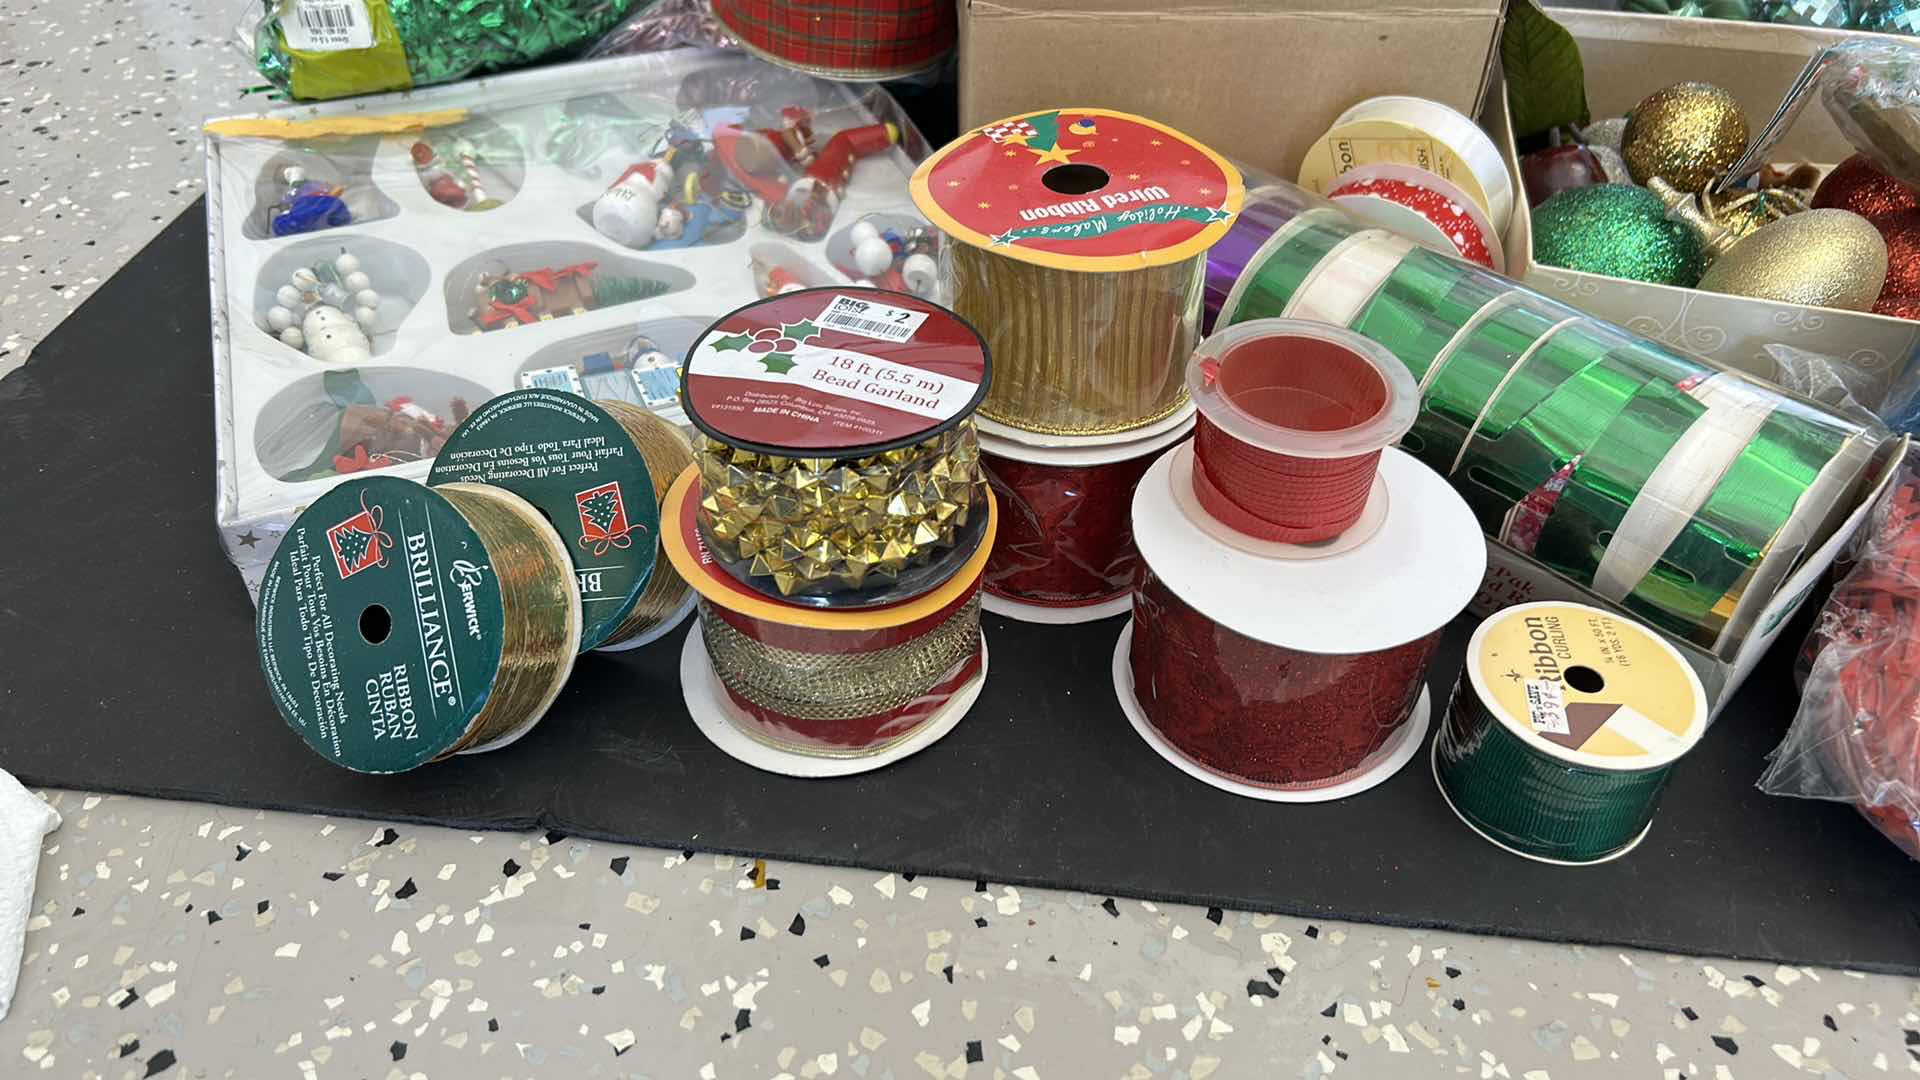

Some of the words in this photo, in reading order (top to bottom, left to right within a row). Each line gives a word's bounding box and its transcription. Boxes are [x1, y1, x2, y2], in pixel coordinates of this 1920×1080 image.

[1100, 186, 1170, 209] Wired
[1019, 198, 1101, 222] Ribbon
[828, 356, 854, 370] 18
[857, 362, 873, 376] ft
[874, 367, 914, 385] (5.5
[916, 379, 944, 395] m)
[812, 368, 861, 390] Bead
[863, 382, 940, 409] Garland
[753, 406, 779, 414] MADE
[779, 408, 791, 416] IN
[791, 410, 820, 423] CHINA
[500, 446, 512, 457] De
[514, 442, 536, 454] Tipo
[537, 442, 561, 453] Todo
[562, 439, 582, 449] Para
[584, 436, 605, 448] Ideal
[530, 456, 547, 465] Vos
[548, 453, 570, 463] Tous
[572, 450, 592, 460] Pour
[595, 446, 624, 459] Parfait
[483, 460, 495, 470] En
[497, 457, 529, 469] Besoins
[537, 467, 550, 478] All
[551, 465, 566, 476] For
[569, 462, 598, 474] Perfect
[488, 468, 535, 481] Decorating
[296, 528, 310, 562] Parfait
[290, 550, 302, 576] Ideal
[303, 564, 312, 589] Pour
[312, 555, 325, 591] Perfect
[294, 578, 304, 602] Para
[307, 590, 317, 617] Tous
[318, 593, 328, 611] For
[298, 602, 310, 631] Todo
[322, 614, 333, 629] All
[312, 618, 320, 638] Vos
[1545, 616, 1572, 659] CURLING
[303, 632, 313, 660] Tipo
[316, 640, 328, 679] Besoins
[325, 632, 340, 690] Decorating
[308, 661, 318, 678] De
[322, 681, 332, 697] En
[336, 691, 348, 724] Needs
[365, 679, 386, 740] CINTA
[379, 671, 403, 739] RUBAN
[393, 664, 418, 740] RIBBON
